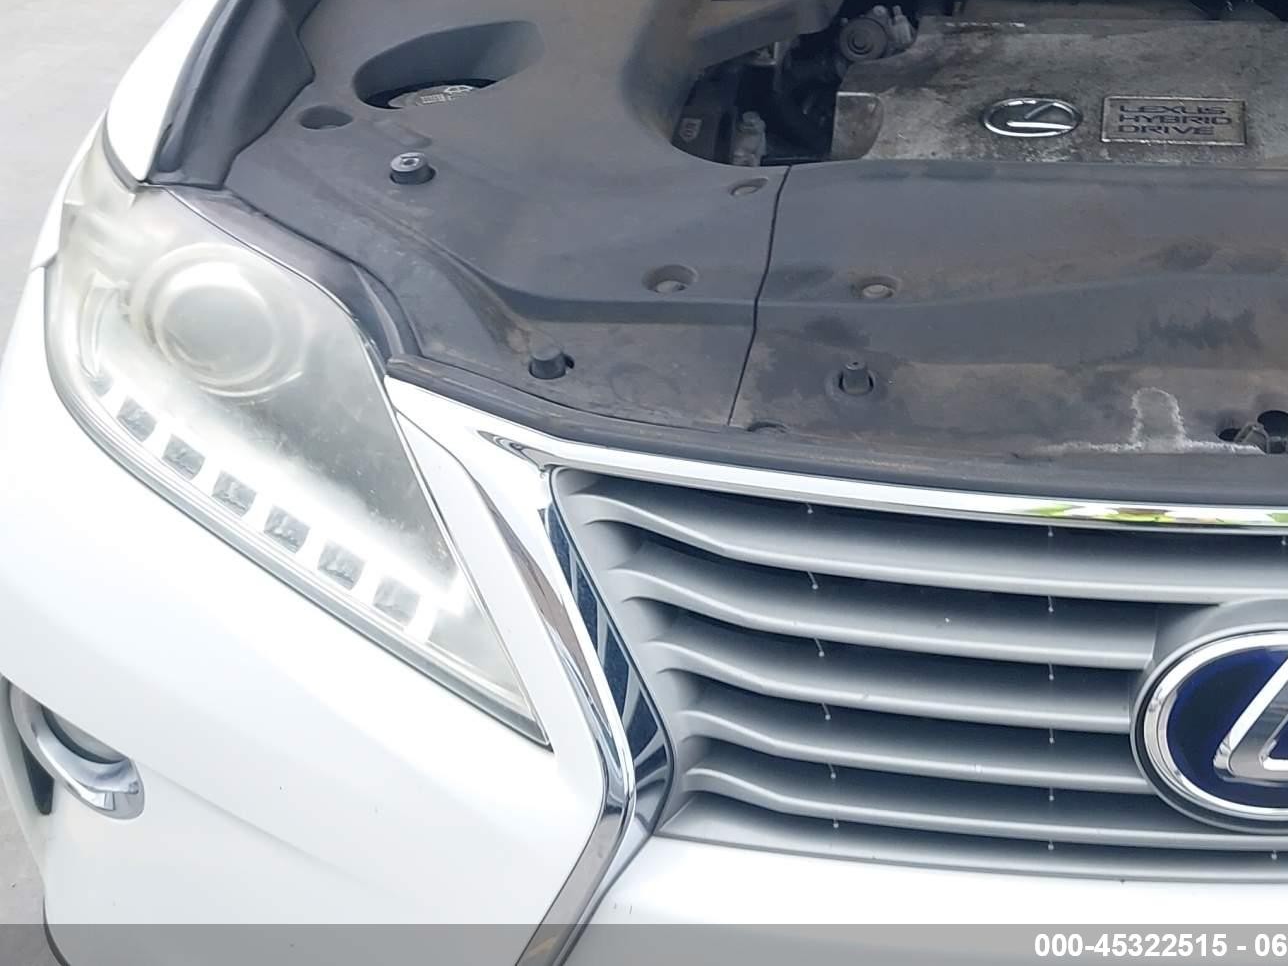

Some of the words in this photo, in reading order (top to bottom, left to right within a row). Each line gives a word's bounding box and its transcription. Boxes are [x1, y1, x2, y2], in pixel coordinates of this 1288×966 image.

[1120, 105, 1226, 115] LEXUS
[1119, 114, 1232, 125] HYBRID
[1118, 124, 1214, 135] DRIVE
